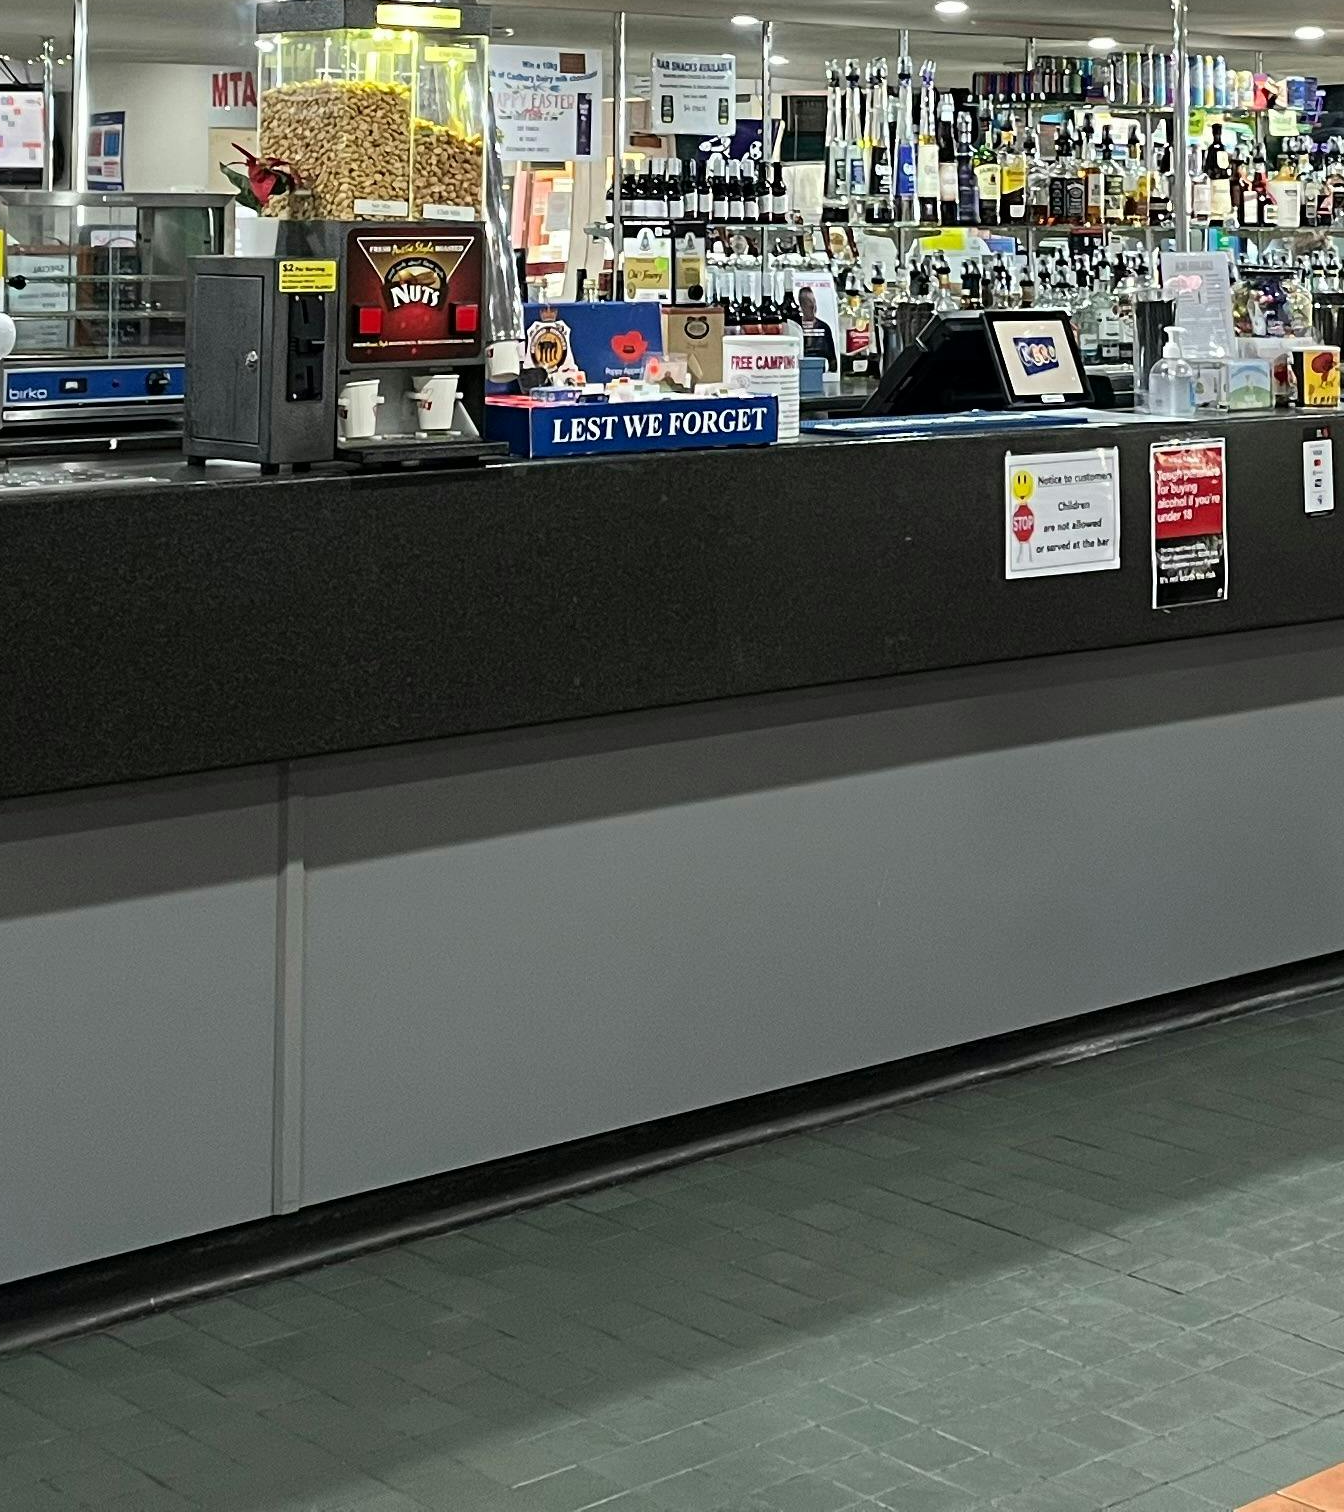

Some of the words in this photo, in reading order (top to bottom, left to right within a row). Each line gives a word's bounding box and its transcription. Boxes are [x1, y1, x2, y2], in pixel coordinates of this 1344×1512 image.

[507, 72, 534, 82] Cadbury
[497, 92, 526, 108] APPY
[532, 92, 574, 109] EASTER
[282, 263, 294, 273] $2
[390, 283, 441, 308] NUTS
[731, 355, 753, 370] FREE
[755, 354, 797, 370] CAMPING
[8, 388, 48, 400] birko
[552, 416, 618, 444] LEST
[623, 413, 663, 439] WE
[668, 407, 768, 436] FORGET
[1037, 475, 1062, 487] Notice
[1064, 474, 1072, 483] to
[1074, 472, 1113, 483] customers
[1156, 469, 1183, 483] Tough
[1157, 479, 1169, 495] for
[1169, 482, 1197, 496] buying
[1057, 500, 1091, 512] Children
[1157, 496, 1187, 509] alcohol
[1195, 493, 1221, 508] you're
[1013, 515, 1034, 533] STOP
[1157, 511, 1181, 524] under
[1183, 508, 1193, 520] 18
[1043, 524, 1055, 533] are
[1057, 521, 1069, 530] not
[1071, 517, 1102, 529] allowed
[1036, 545, 1044, 554] or
[1046, 540, 1070, 552] served
[1072, 540, 1080, 550] at
[1082, 538, 1095, 548] the
[1097, 536, 1110, 547] bar
